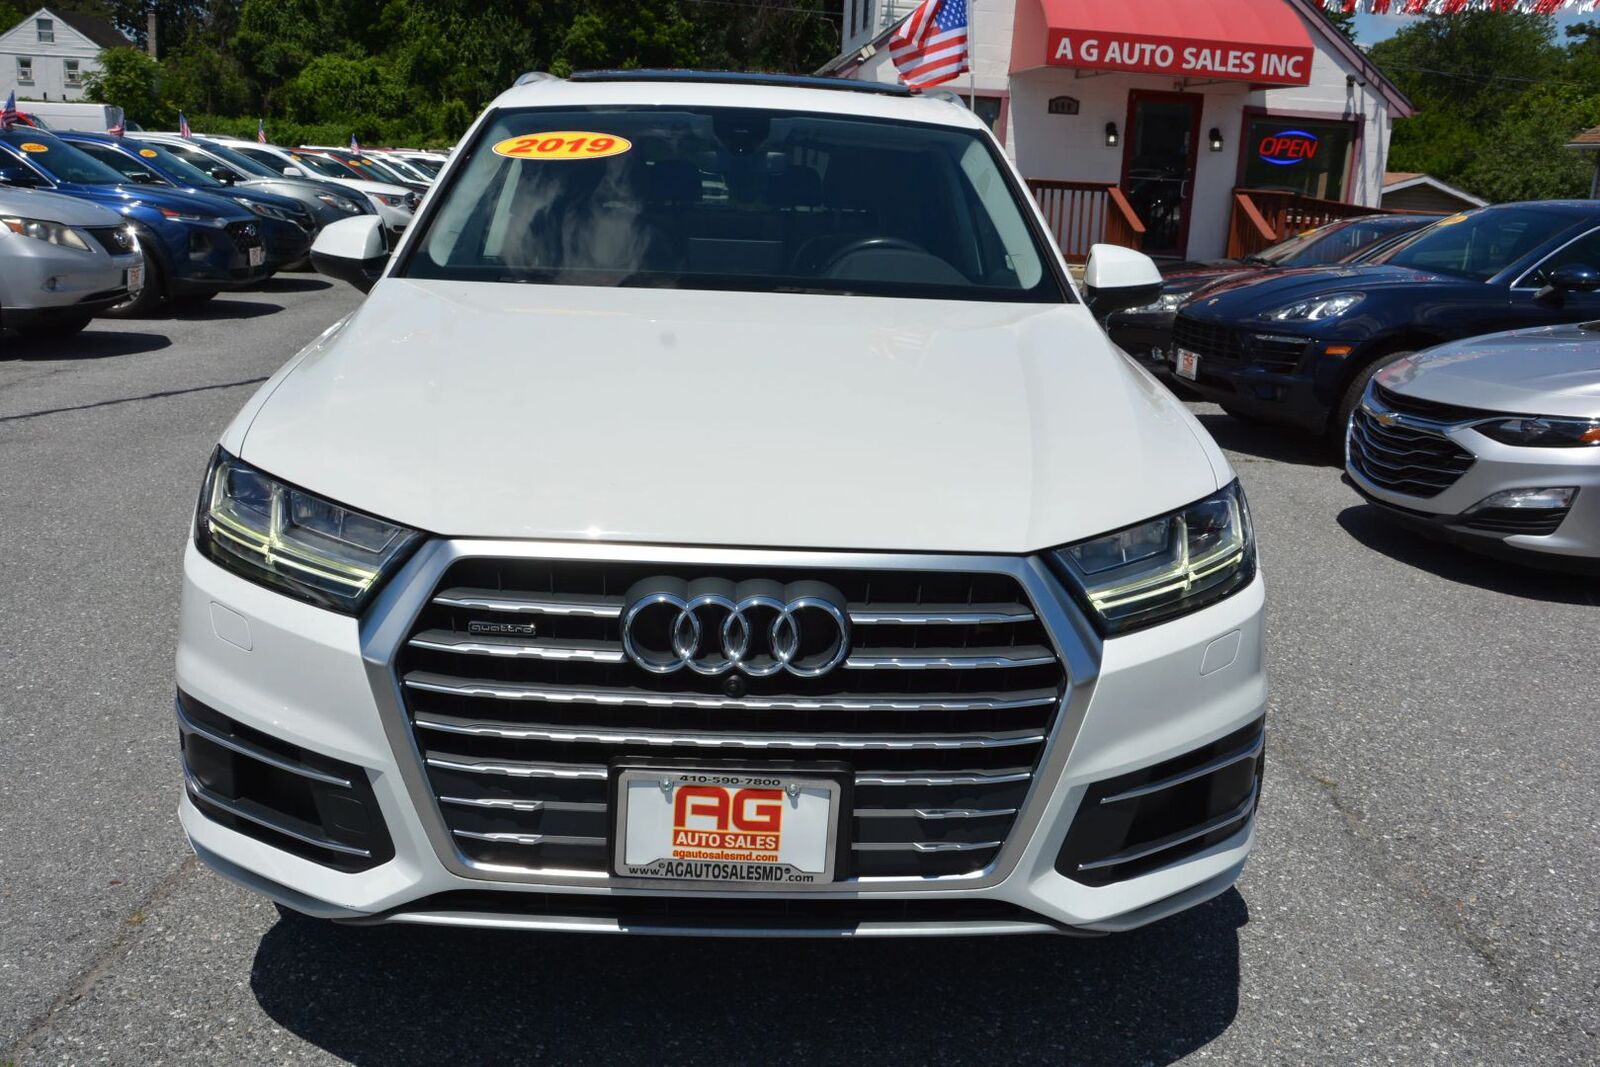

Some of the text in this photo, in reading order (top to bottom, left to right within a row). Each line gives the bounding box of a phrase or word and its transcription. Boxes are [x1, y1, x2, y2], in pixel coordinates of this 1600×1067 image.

[1055, 37, 1304, 78] A G AUTO SALES INC
[507, 137, 616, 154] 2019
[1259, 136, 1318, 159] OPEN
[471, 624, 532, 633] quattro
[679, 775, 781, 786] 410-590-7800
[674, 784, 783, 832] AG
[676, 832, 776, 850] AUTO SALES
[672, 849, 778, 862] agautosalesmd.com
